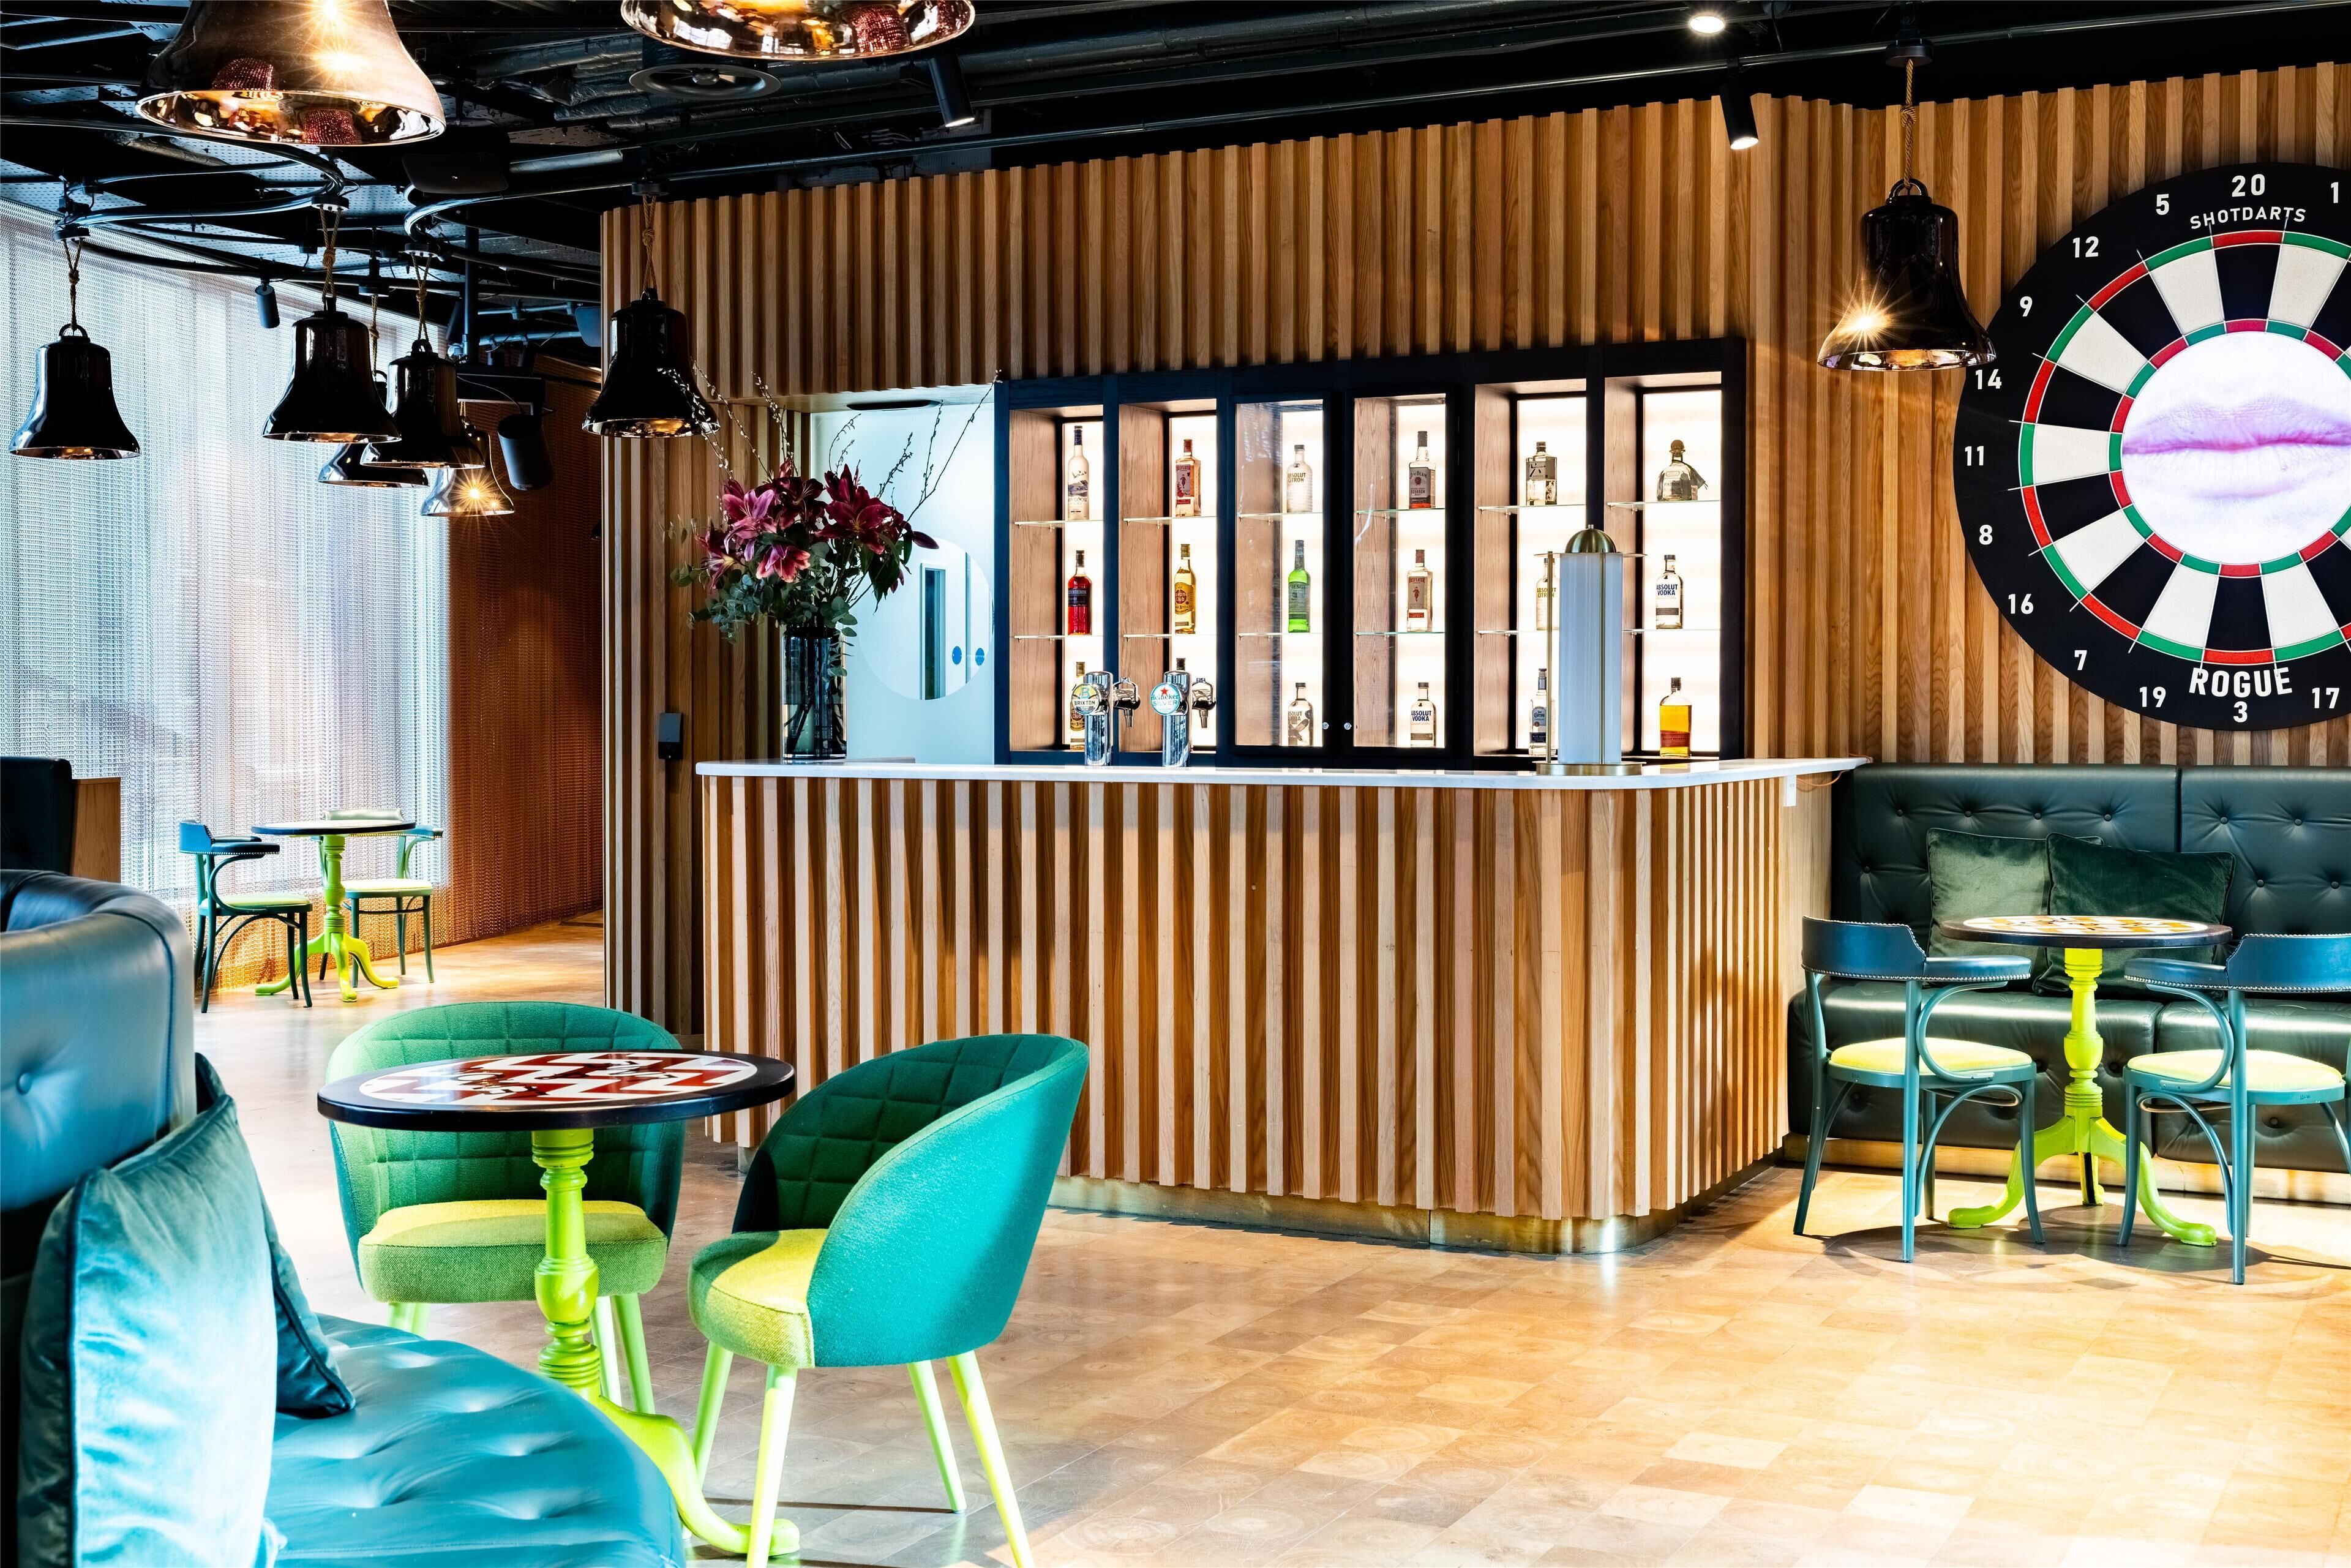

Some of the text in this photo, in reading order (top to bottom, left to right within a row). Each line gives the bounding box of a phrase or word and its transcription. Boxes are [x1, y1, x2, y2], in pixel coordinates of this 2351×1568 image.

[2232, 173, 2265, 197] 20
[2330, 181, 2339, 204] 1
[2156, 193, 2170, 216] 5
[2190, 206, 2307, 230] SHOTDARTS
[2072, 236, 2099, 258] 12
[2019, 296, 2033, 317] 9
[1975, 369, 2002, 390] 14
[1965, 445, 1984, 467] 11
[1979, 524, 1993, 546] 8
[2008, 593, 2034, 615] 16
[2074, 650, 2088, 671] 7
[2189, 667, 2293, 698] ROGUE
[2139, 686, 2166, 708] 19
[2312, 687, 2340, 709] 17
[2233, 700, 2248, 723] 3
